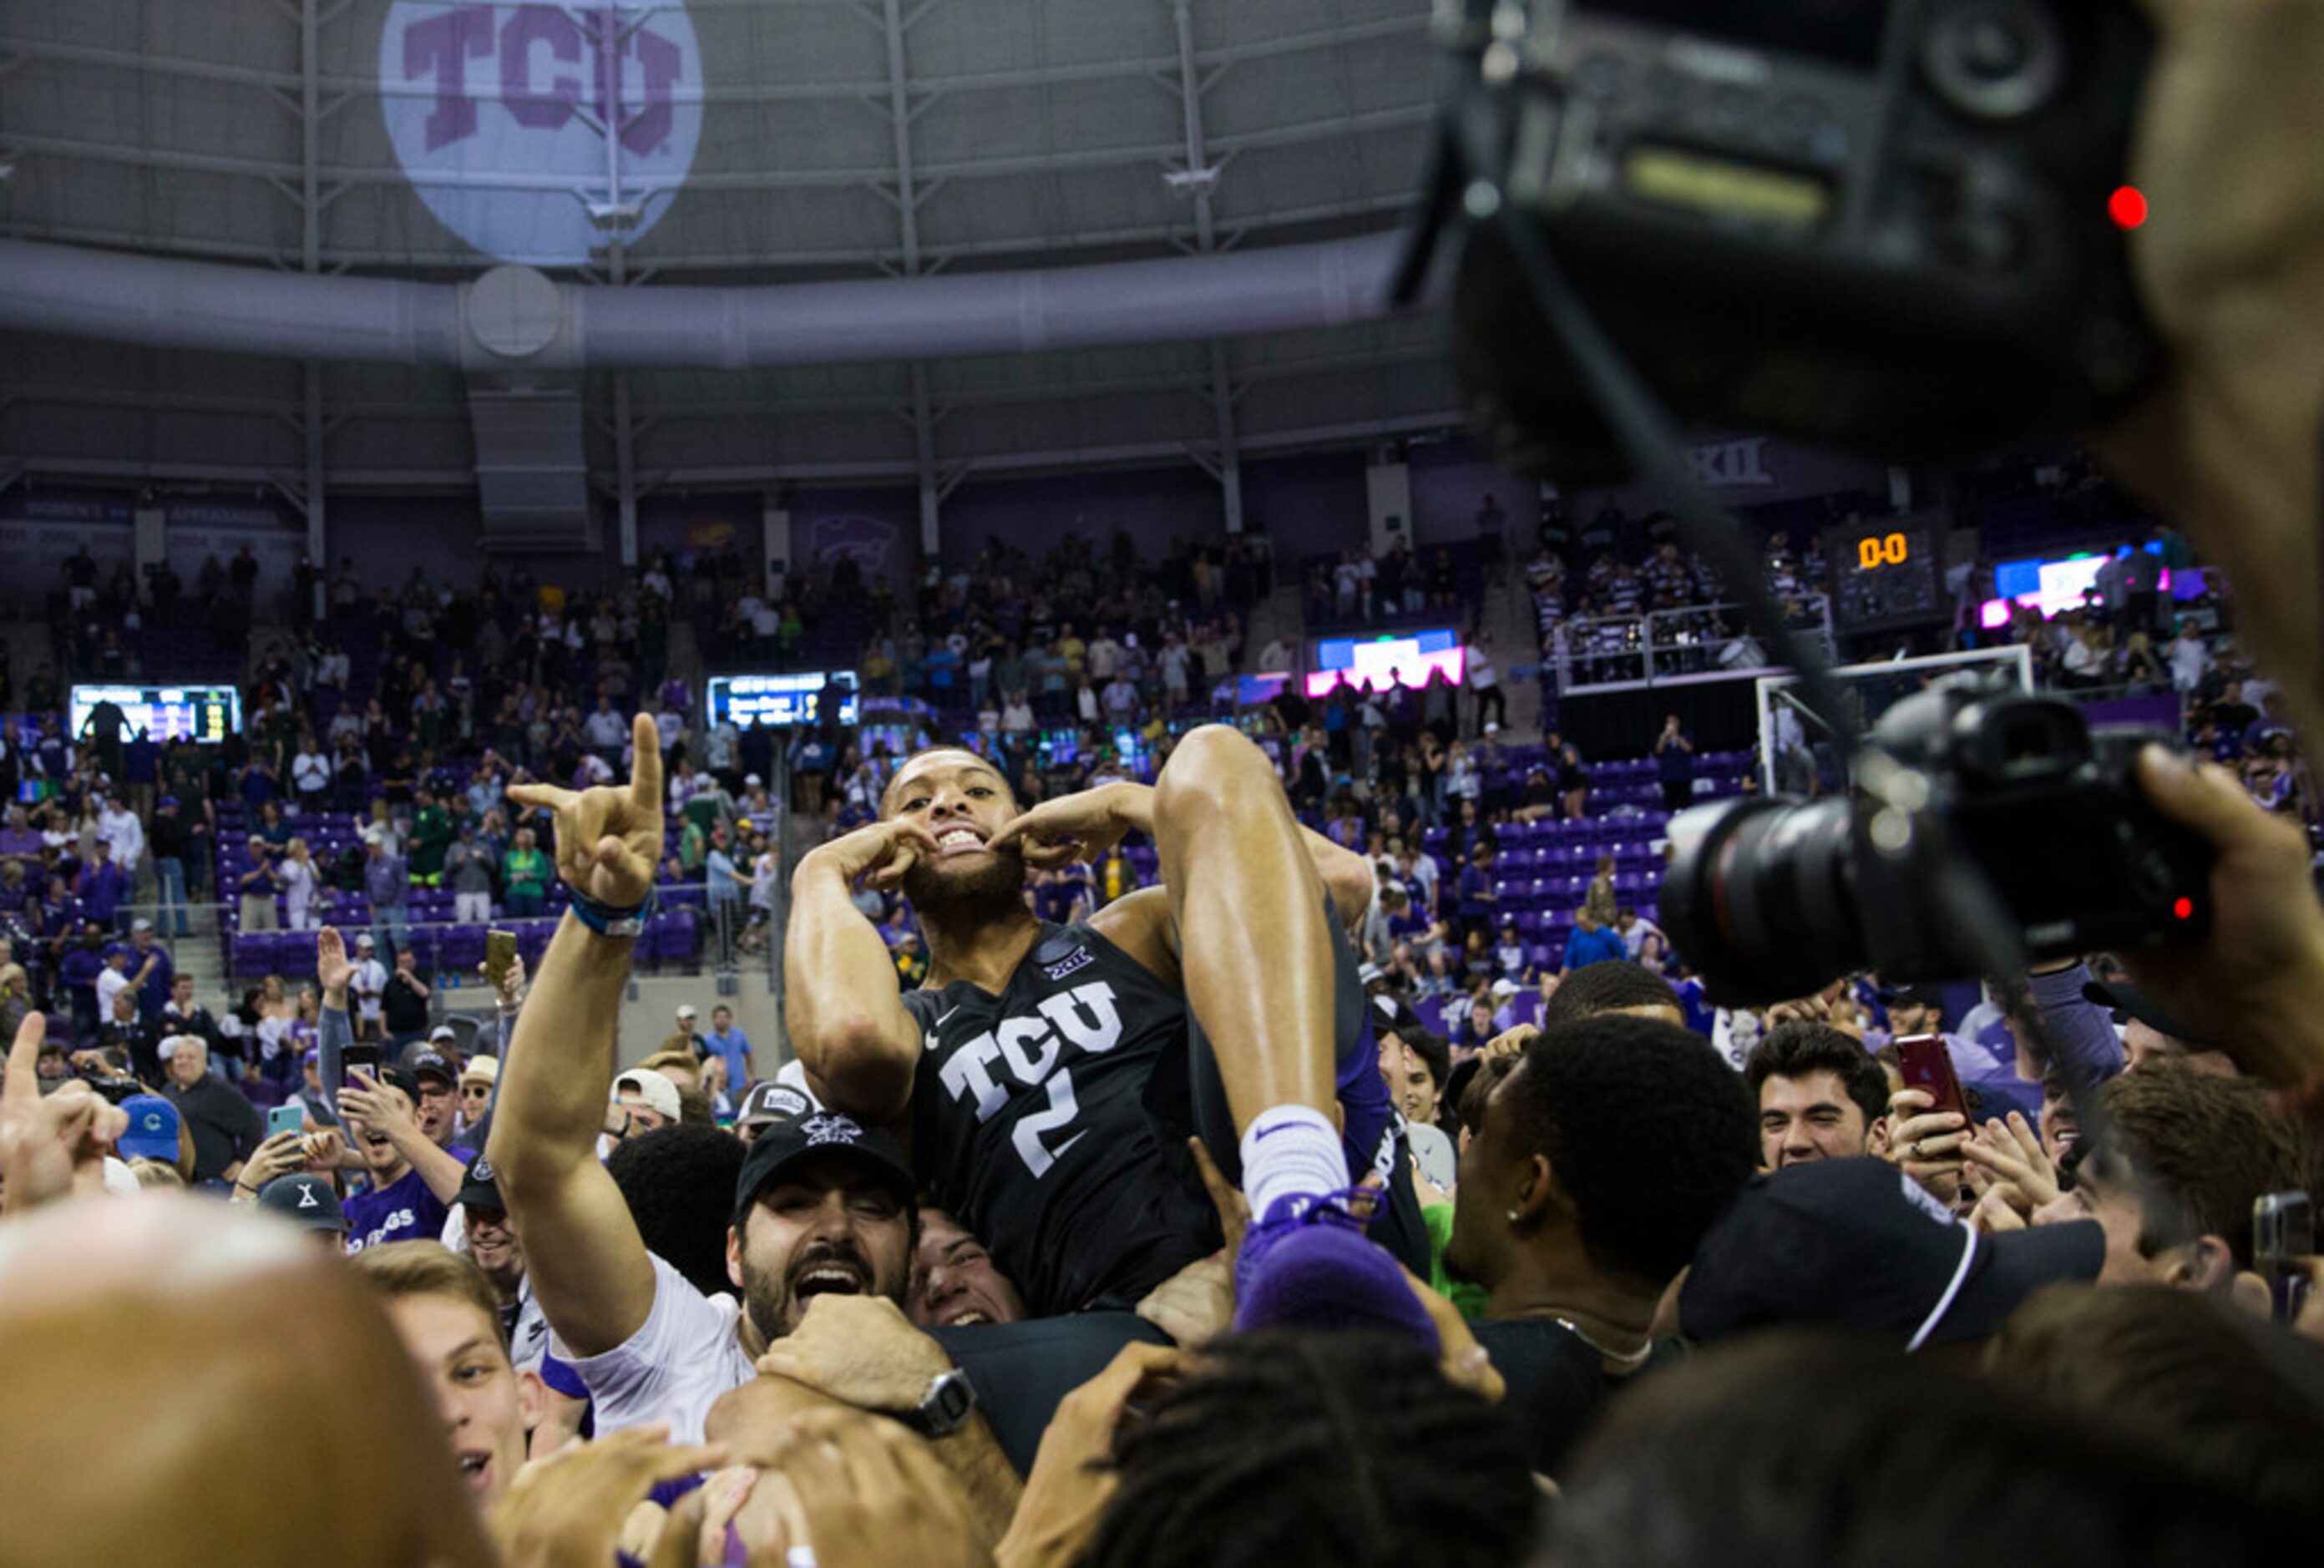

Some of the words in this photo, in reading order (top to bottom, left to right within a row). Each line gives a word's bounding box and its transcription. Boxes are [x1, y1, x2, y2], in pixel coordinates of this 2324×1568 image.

[403, 3, 682, 159] TCU
[1859, 533, 1907, 569] 0-0
[939, 980, 1123, 1125] TCU
[1011, 1066, 1090, 1181] 2
